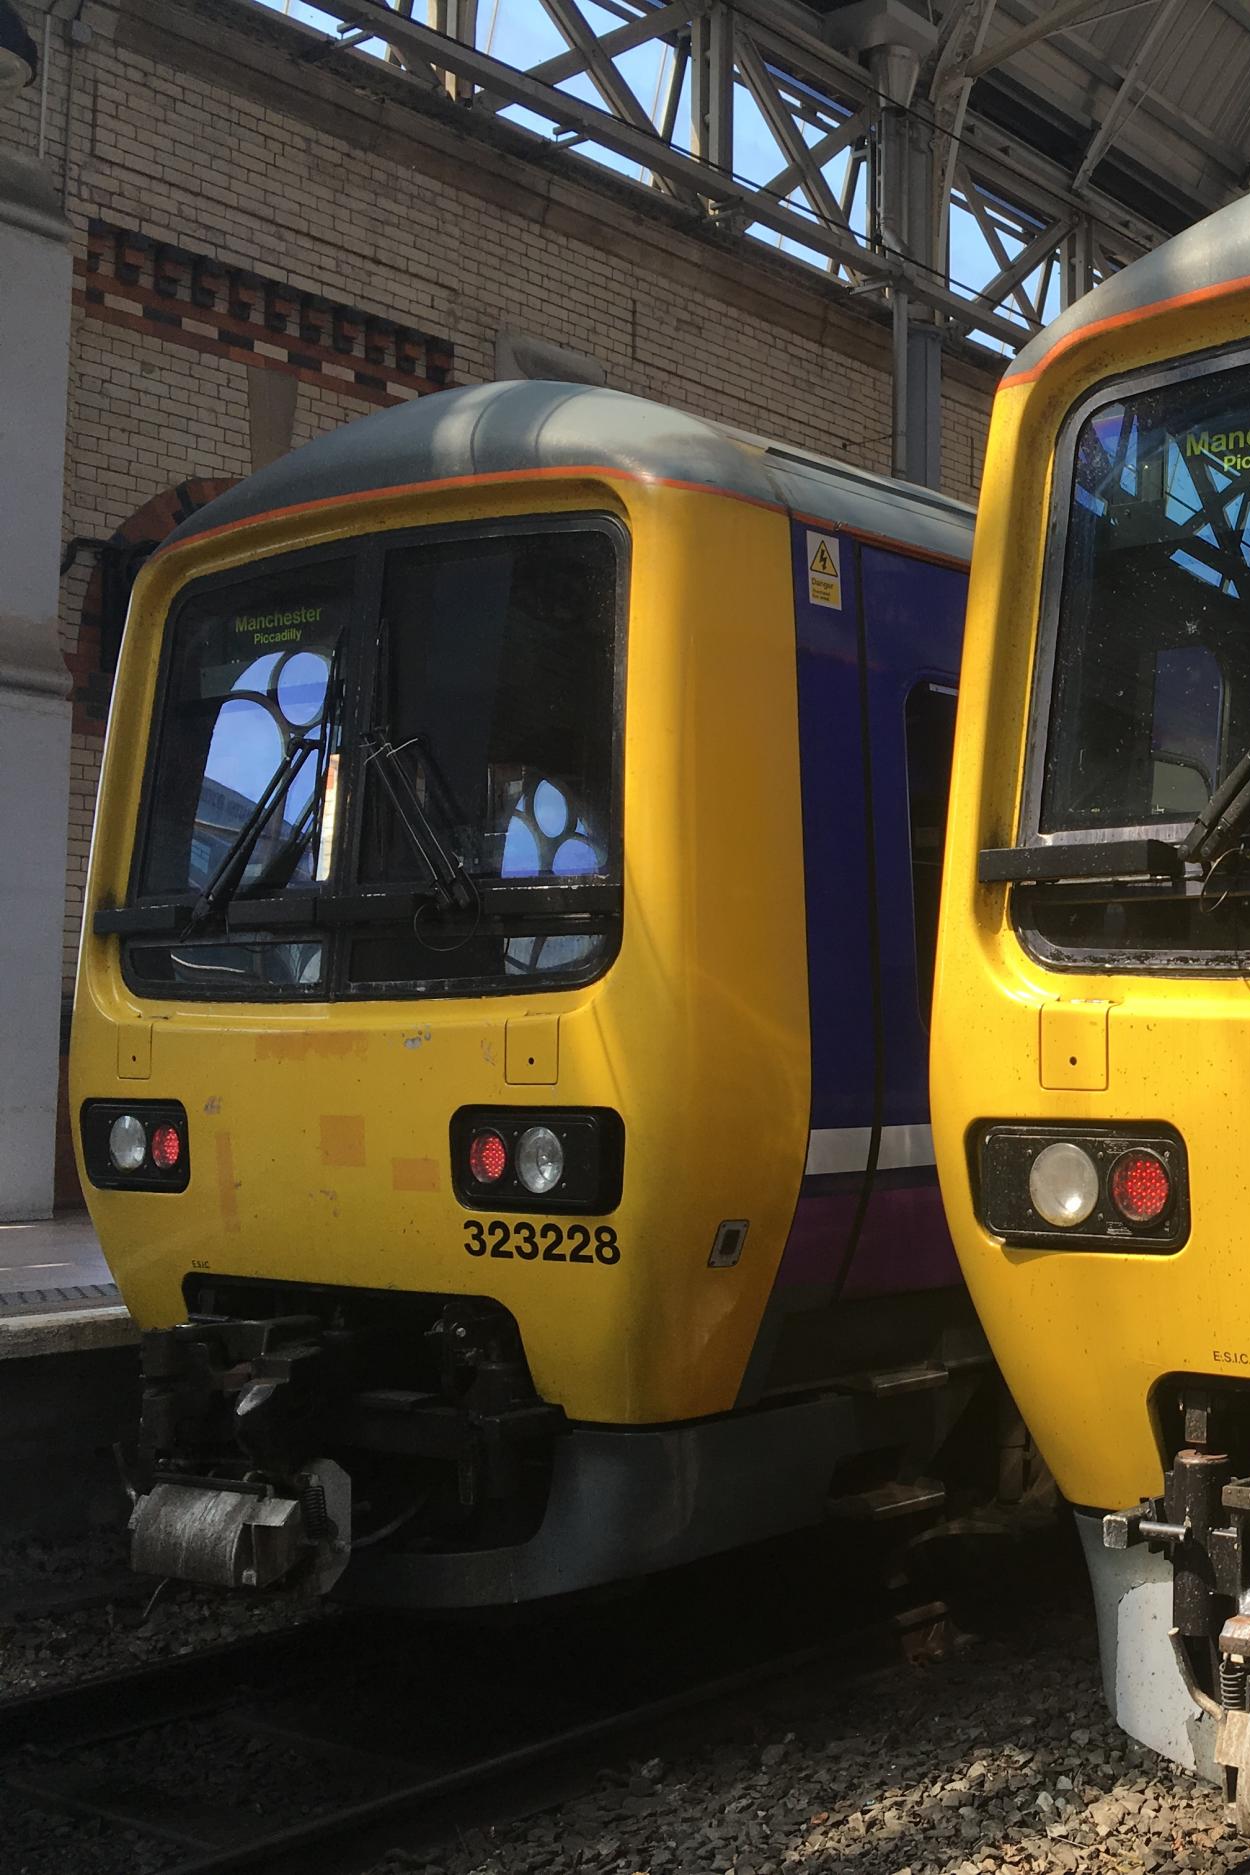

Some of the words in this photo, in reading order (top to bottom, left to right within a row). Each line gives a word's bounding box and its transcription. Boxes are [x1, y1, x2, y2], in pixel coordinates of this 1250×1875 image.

[235, 606, 322, 632] Manchester
[254, 628, 302, 645] Piccadilly
[464, 1220, 621, 1265] 323228
